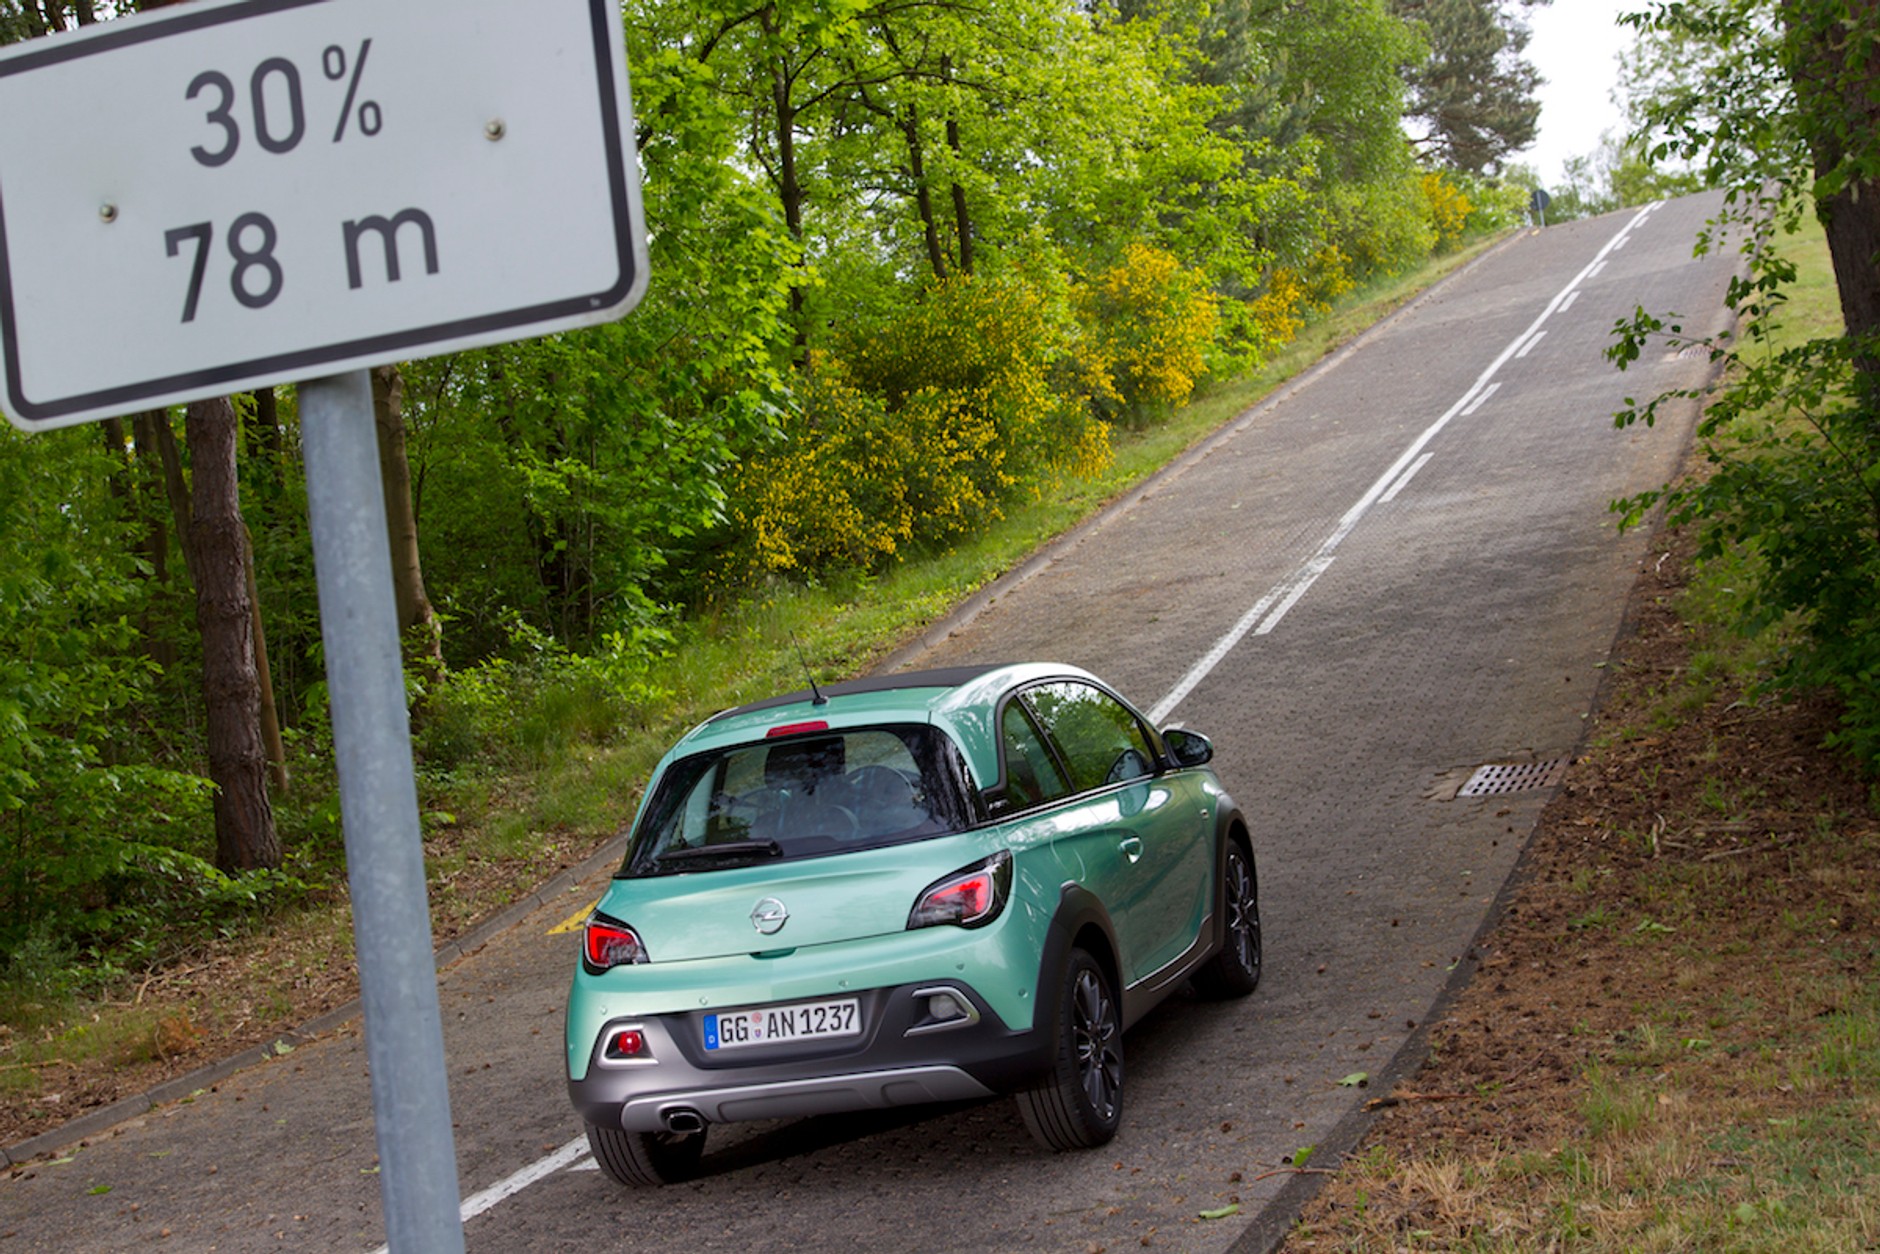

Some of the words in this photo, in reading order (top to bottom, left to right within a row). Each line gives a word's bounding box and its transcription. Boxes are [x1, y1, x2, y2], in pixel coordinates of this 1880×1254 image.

[185, 38, 383, 168] 30%
[164, 211, 284, 324] 78
[342, 207, 440, 290] m
[719, 1015, 749, 1043] GG
[767, 1010, 795, 1039] AN
[799, 1003, 856, 1035] 1237
